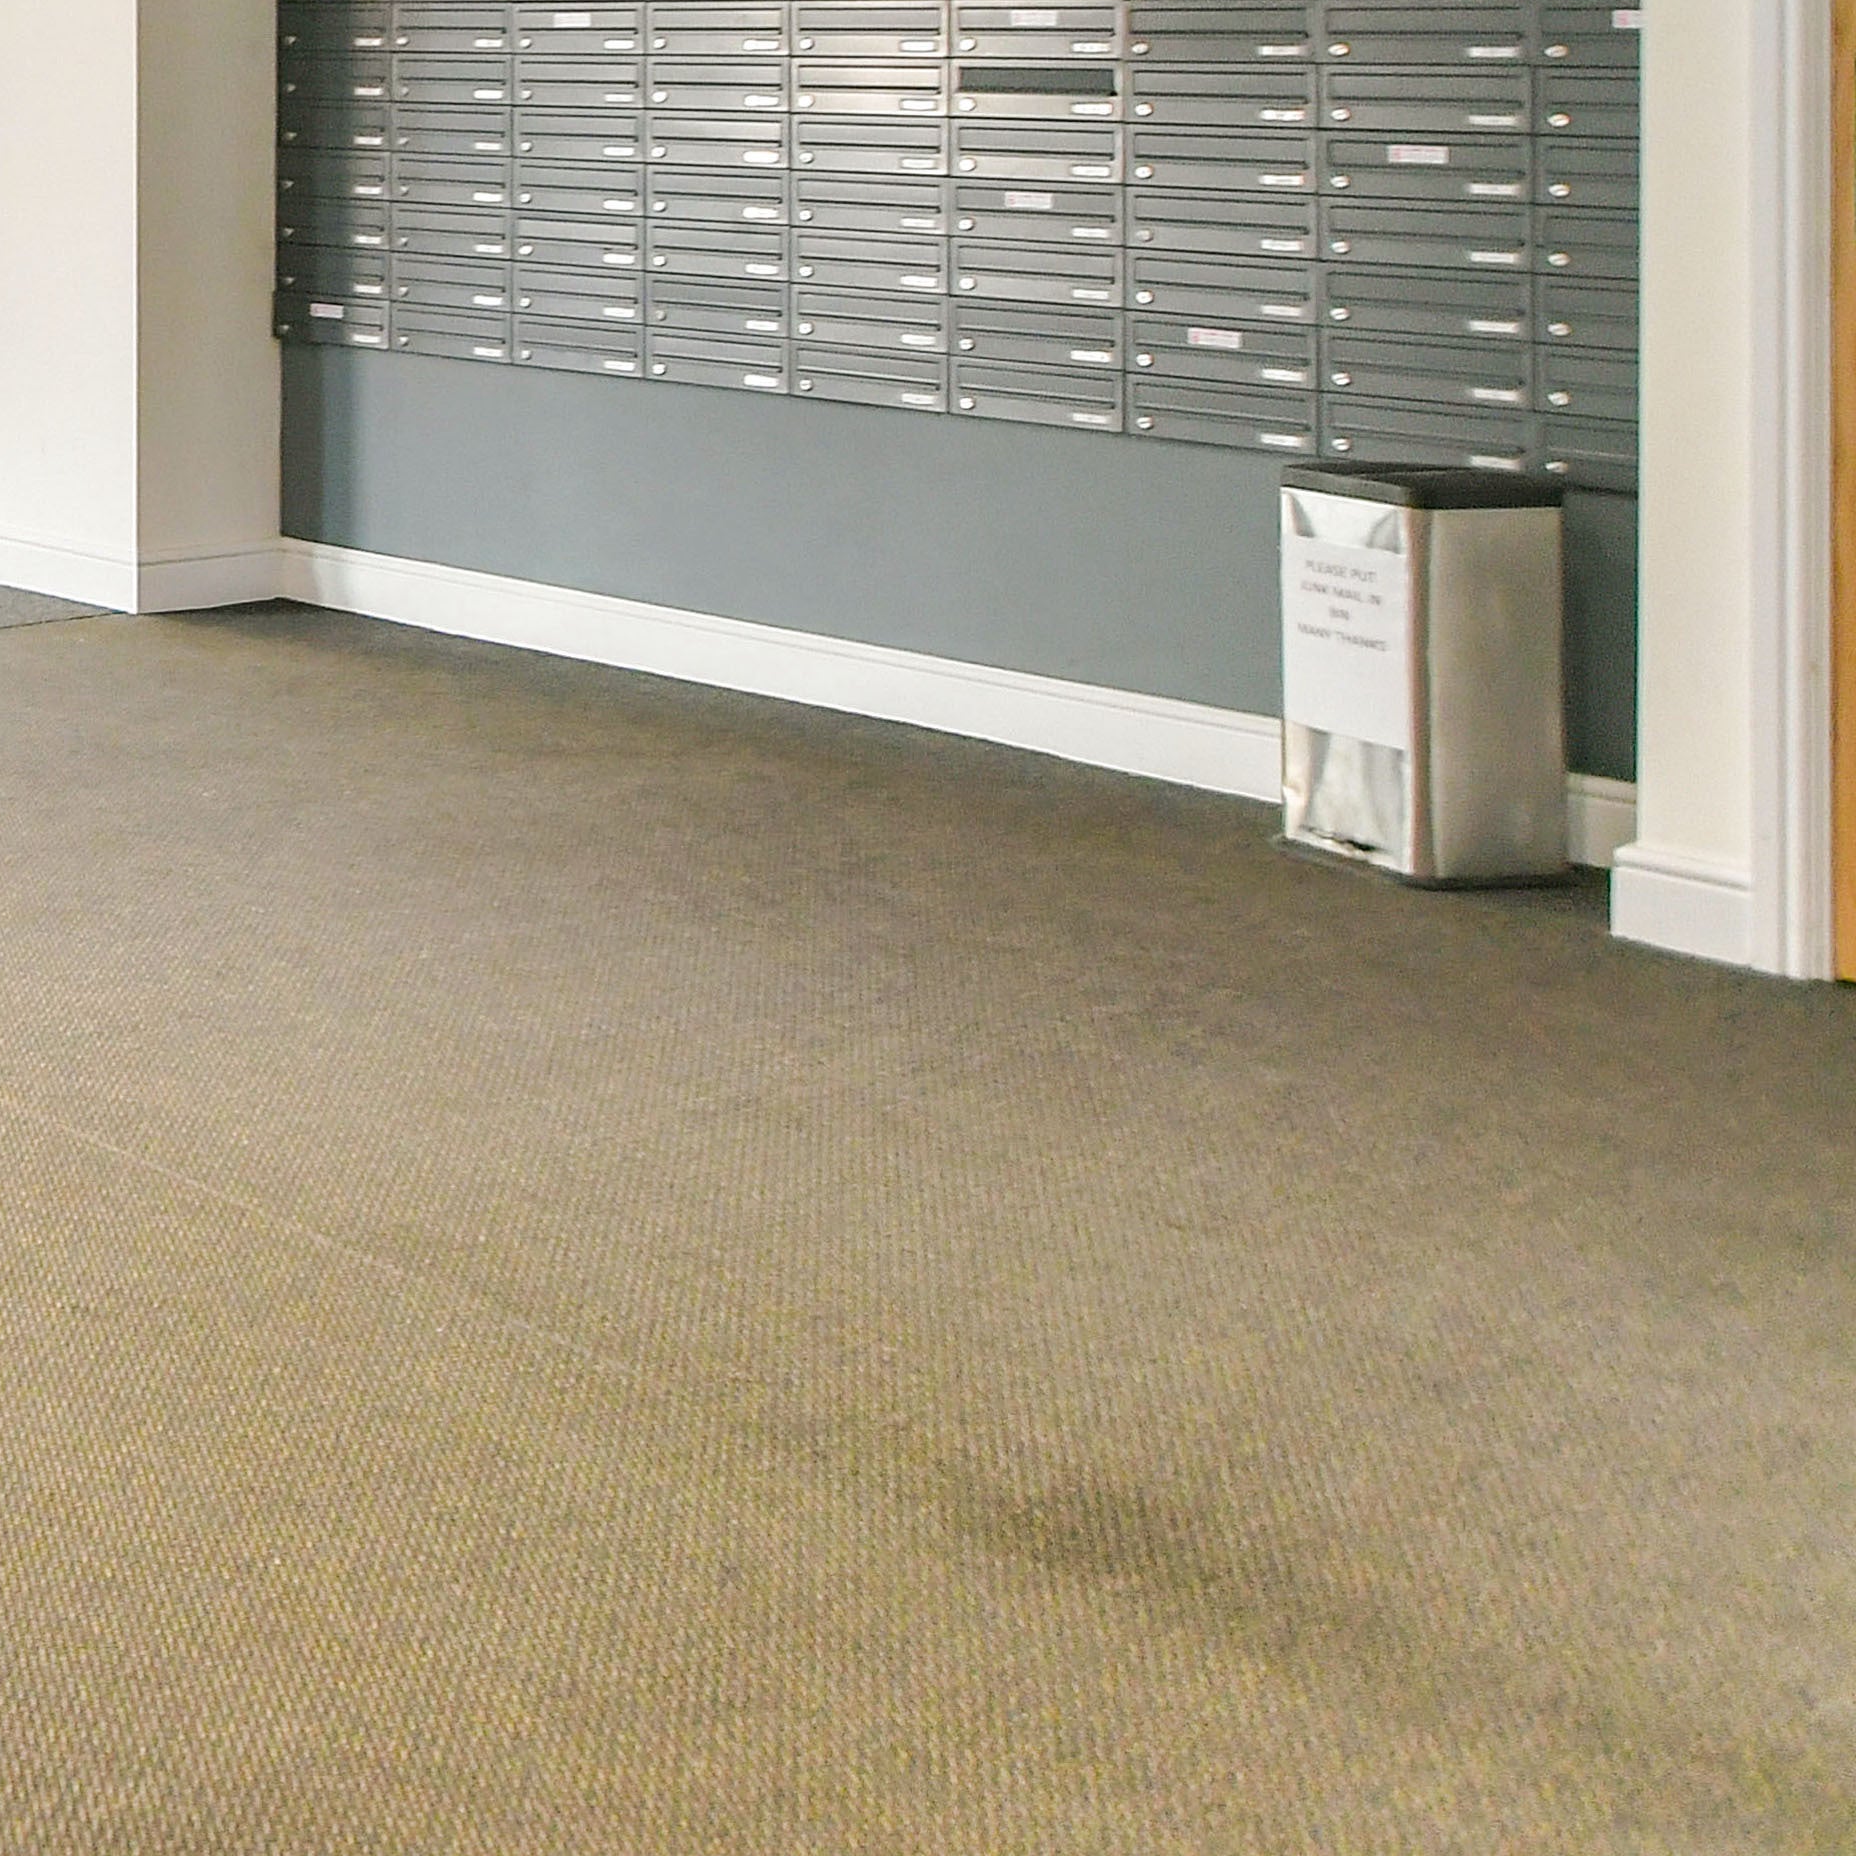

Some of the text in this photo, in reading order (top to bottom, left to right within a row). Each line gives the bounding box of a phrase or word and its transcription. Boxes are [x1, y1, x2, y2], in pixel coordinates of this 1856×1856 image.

[1305, 559, 1377, 583] PLEASE PUT
[1300, 580, 1329, 594] JUNK
[1333, 587, 1363, 604] MAIL
[1297, 622, 1389, 652] MANY THANKS
